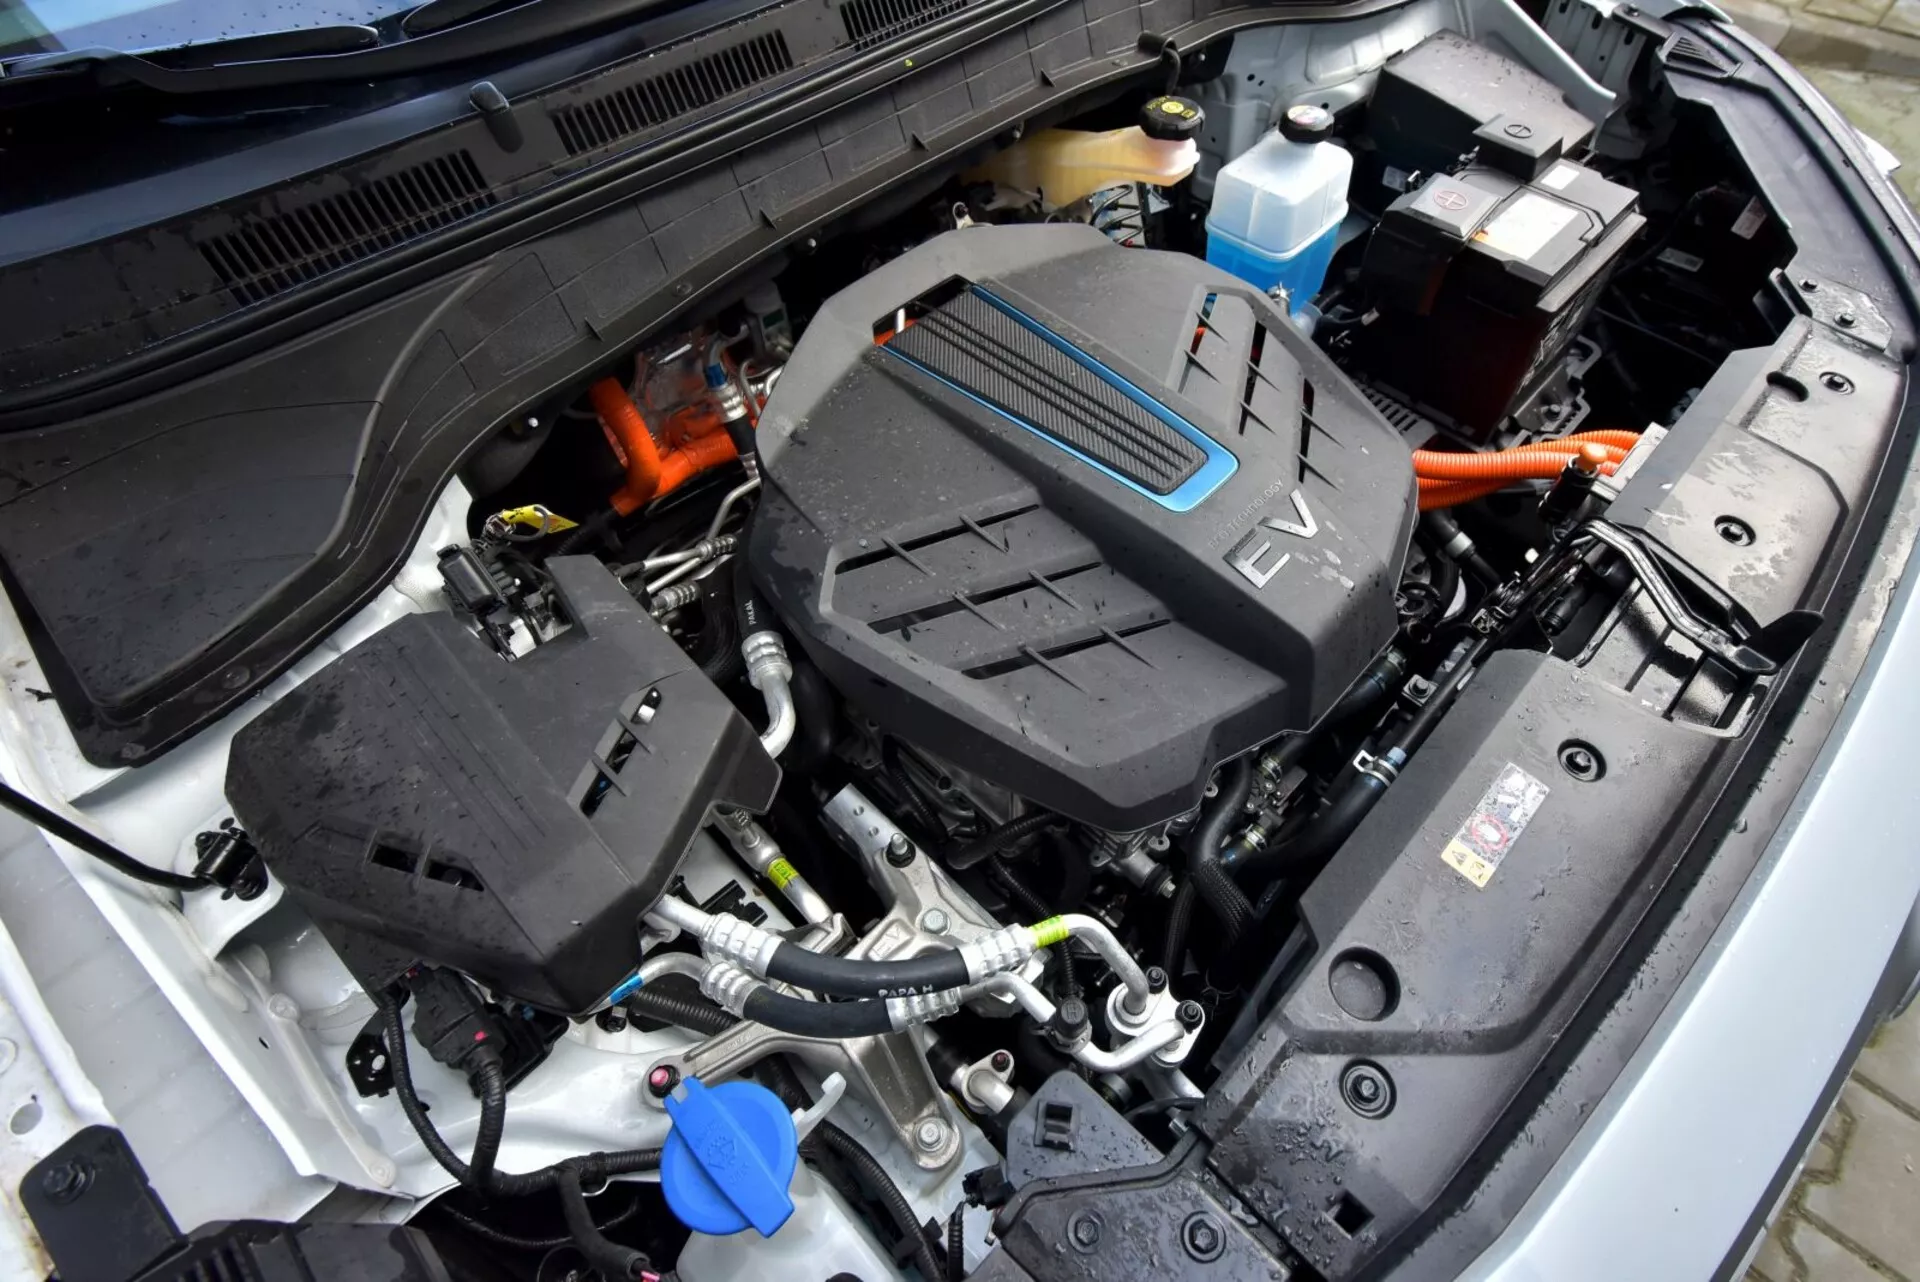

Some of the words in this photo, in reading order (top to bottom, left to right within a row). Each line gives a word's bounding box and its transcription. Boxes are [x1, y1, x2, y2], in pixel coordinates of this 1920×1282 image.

[1222, 488, 1319, 589] EV
[878, 986, 918, 998] PAPA
[922, 983, 933, 994] H
